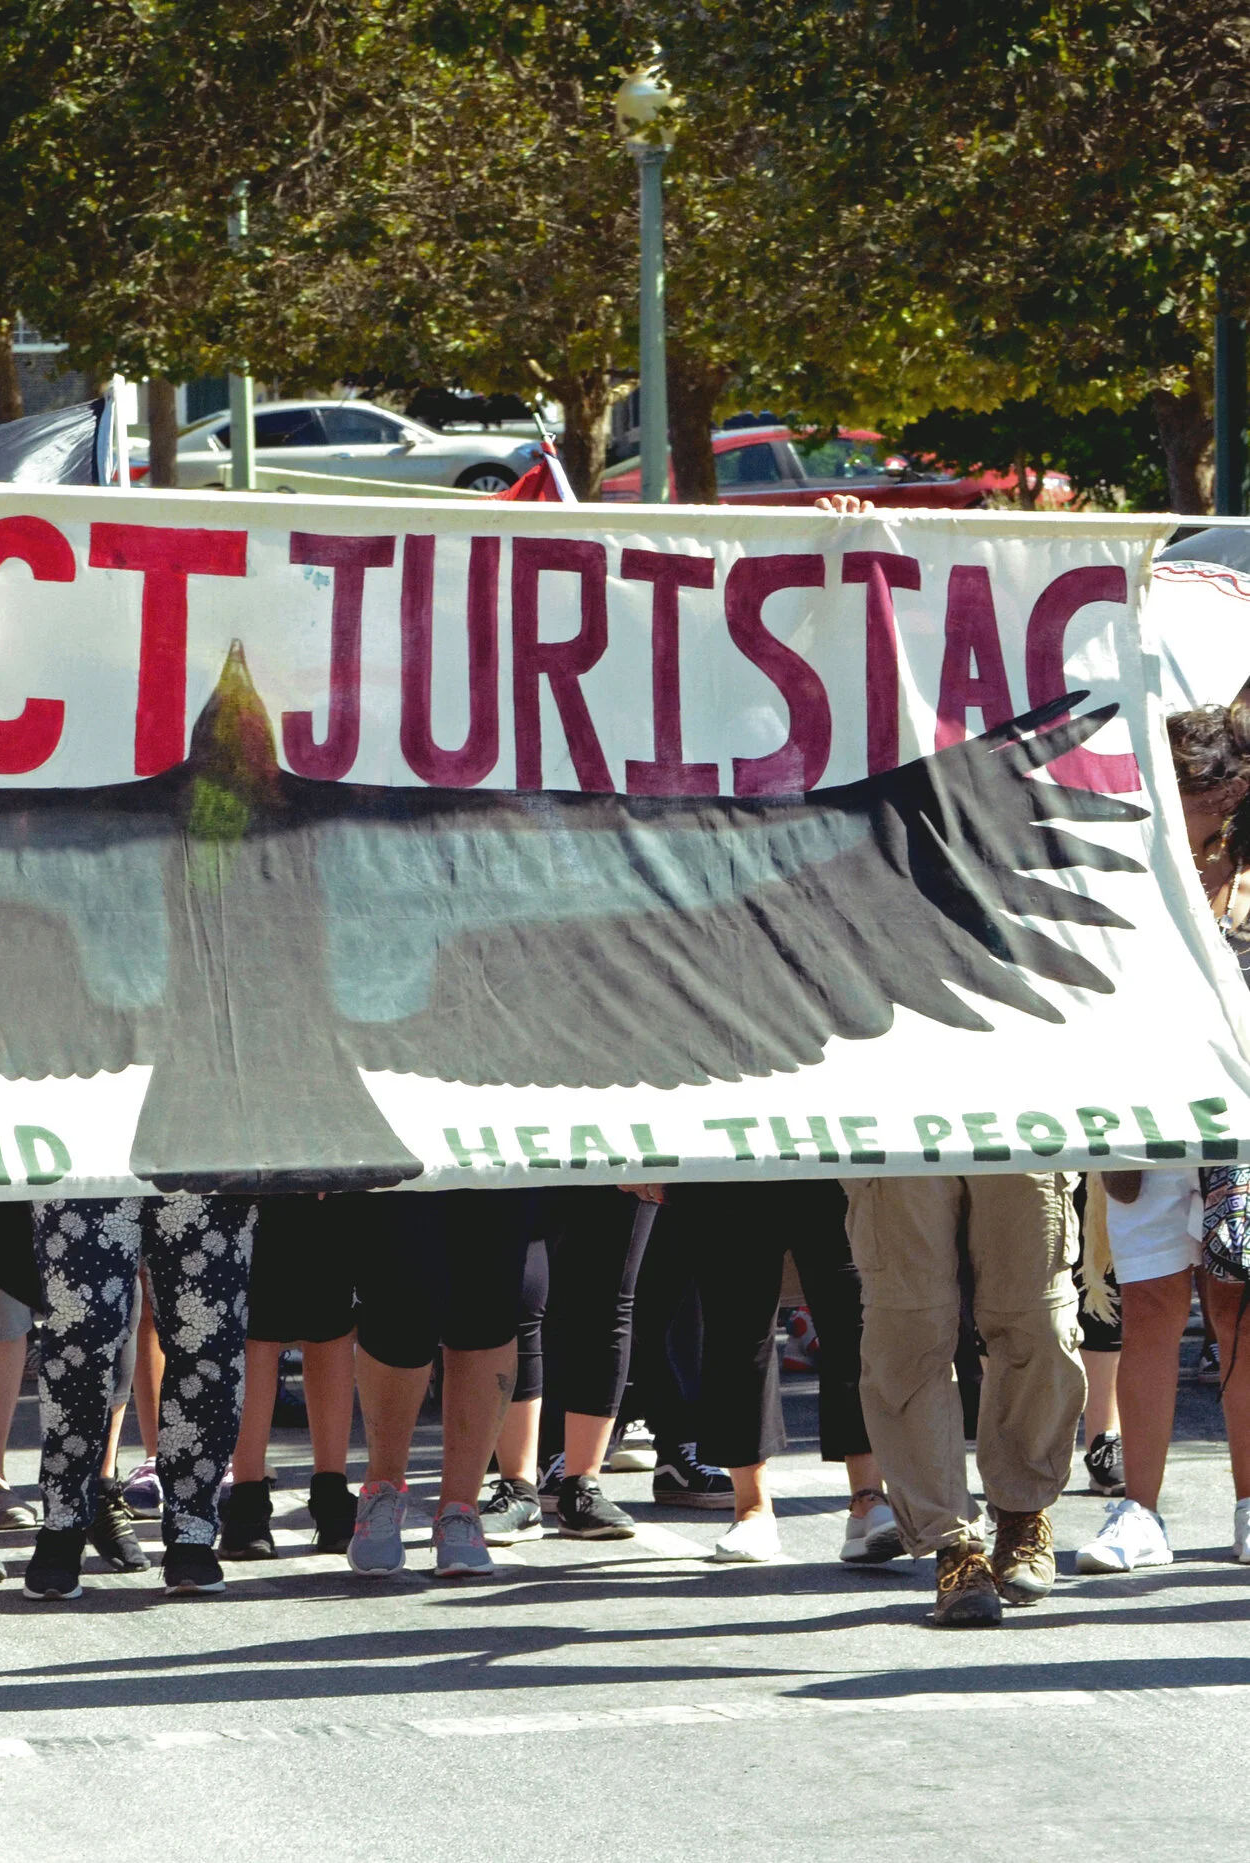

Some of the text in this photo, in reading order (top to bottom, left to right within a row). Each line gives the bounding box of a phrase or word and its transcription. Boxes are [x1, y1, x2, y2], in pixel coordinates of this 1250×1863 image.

[282, 530, 1143, 798] JURISTAC
[442, 1122, 680, 1169] HEAL
[703, 1115, 886, 1165] THE
[913, 1096, 1239, 1162] PEOPLE
